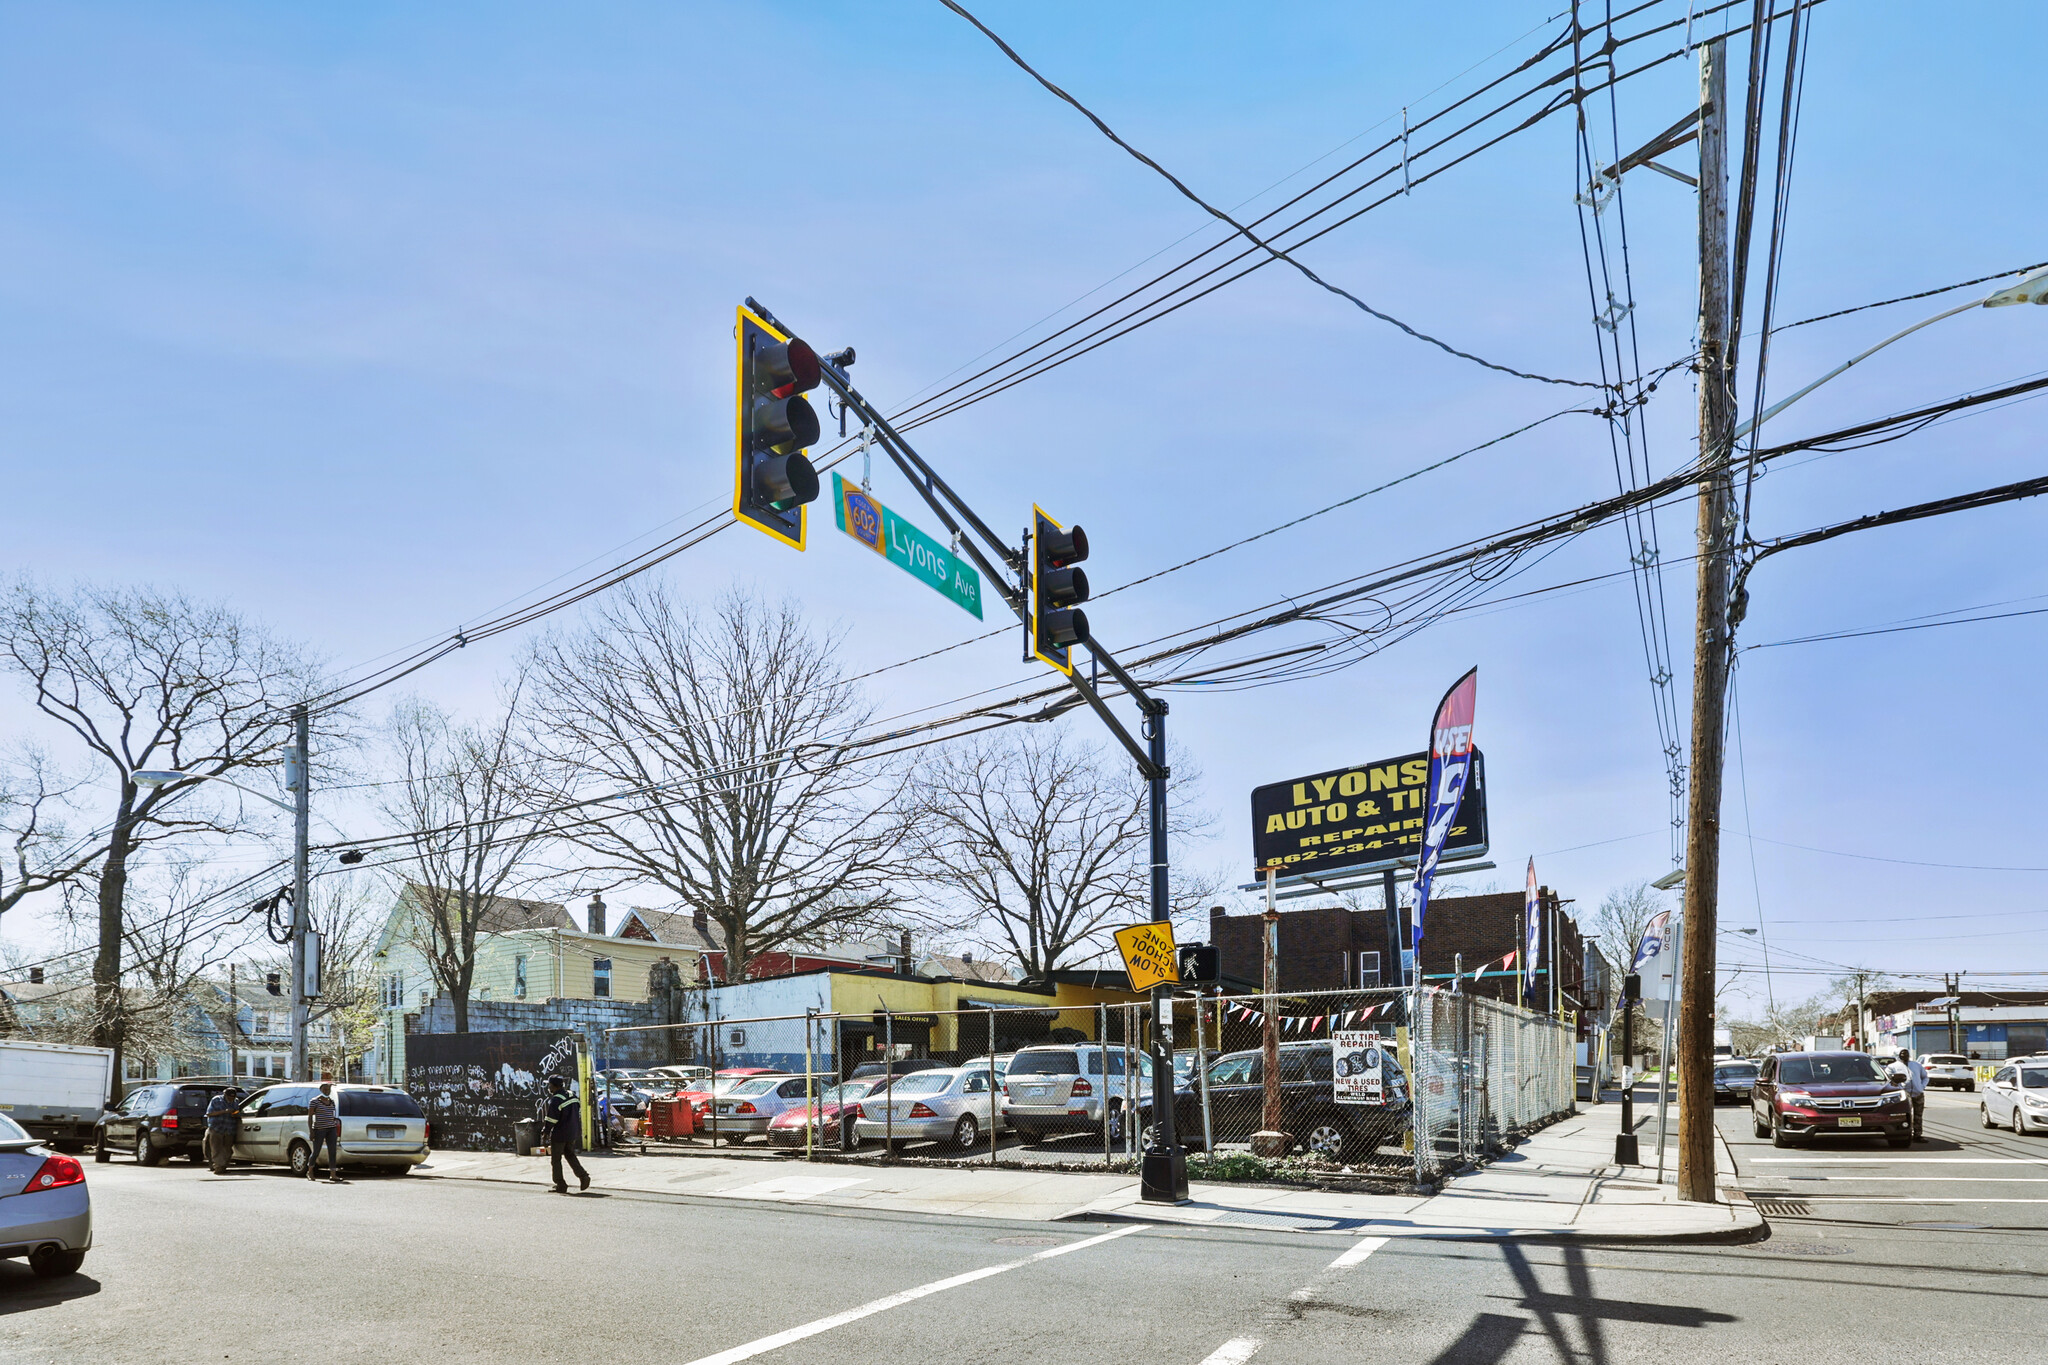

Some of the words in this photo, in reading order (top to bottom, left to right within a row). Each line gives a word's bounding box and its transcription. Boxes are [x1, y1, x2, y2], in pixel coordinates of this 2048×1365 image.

[853, 506, 876, 536] 602
[890, 518, 947, 582] Lyons
[954, 571, 976, 601] Ave
[1433, 724, 1471, 756] USE
[1292, 760, 1428, 806] LYONS
[1265, 802, 1348, 834] AUTO
[1356, 800, 1381, 818] &
[1387, 787, 1427, 812] TI
[1266, 826, 1468, 867] 862-234-152
[1131, 935, 1175, 973] SCHOOL
[1142, 928, 1175, 957] ZONE
[1663, 927, 1671, 951] BUS
[1129, 954, 1167, 978] SLOW
[1334, 1033, 1356, 1041] FLAT
[1359, 1033, 1380, 1041] TIRE
